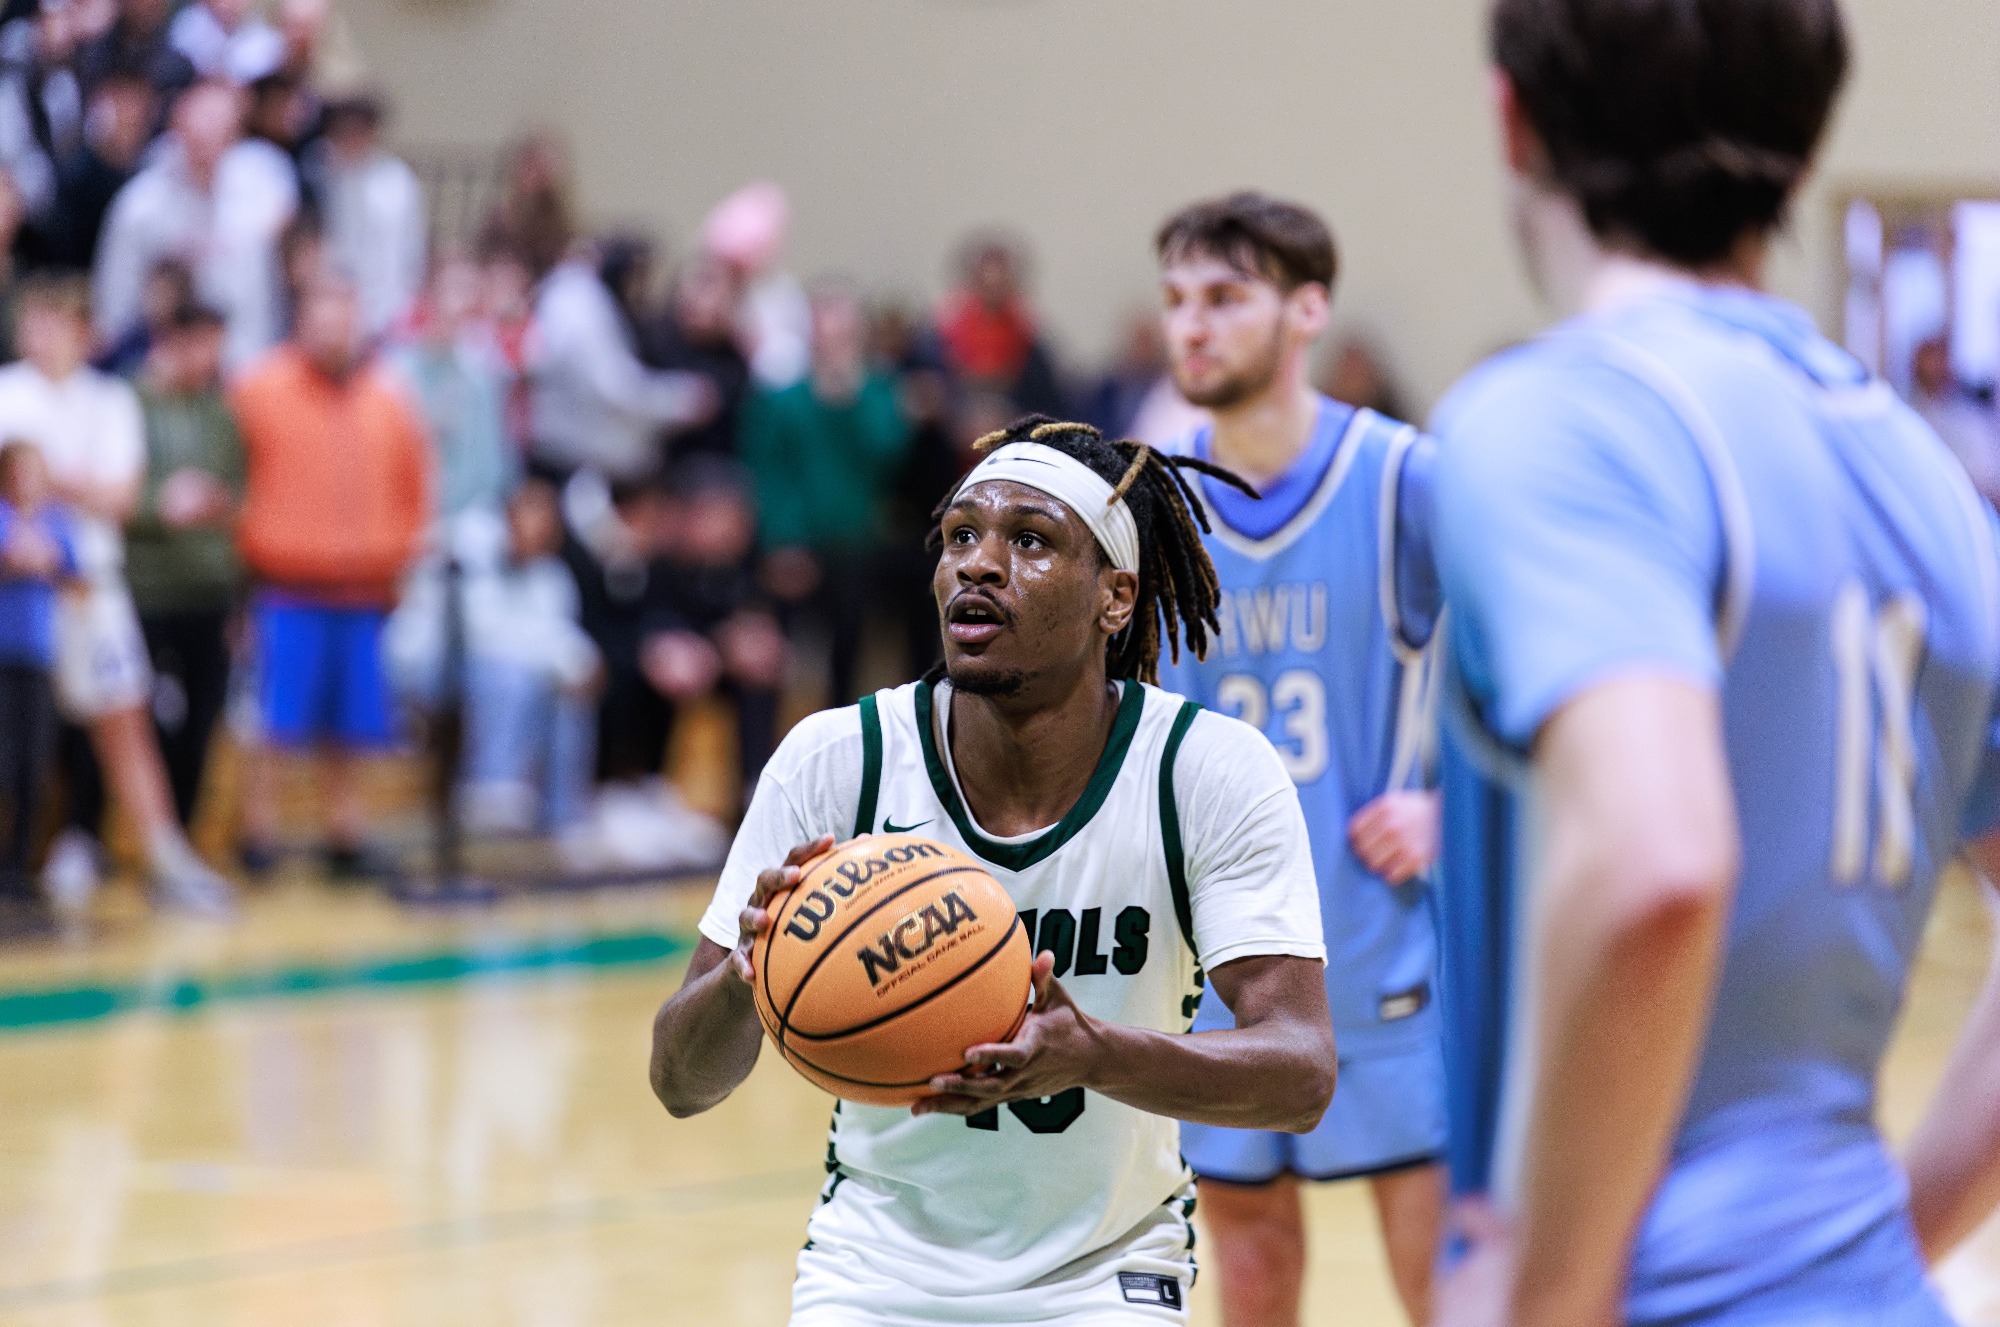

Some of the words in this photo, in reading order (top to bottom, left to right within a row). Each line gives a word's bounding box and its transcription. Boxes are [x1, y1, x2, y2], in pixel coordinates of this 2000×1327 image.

[783, 842, 944, 943] Wilson
[856, 890, 978, 988] NCAA
[876, 961, 926, 998] OFFICIAL
[926, 938, 958, 964] GAME
[959, 923, 985, 943] BALL
[1163, 1284, 1175, 1300] L
